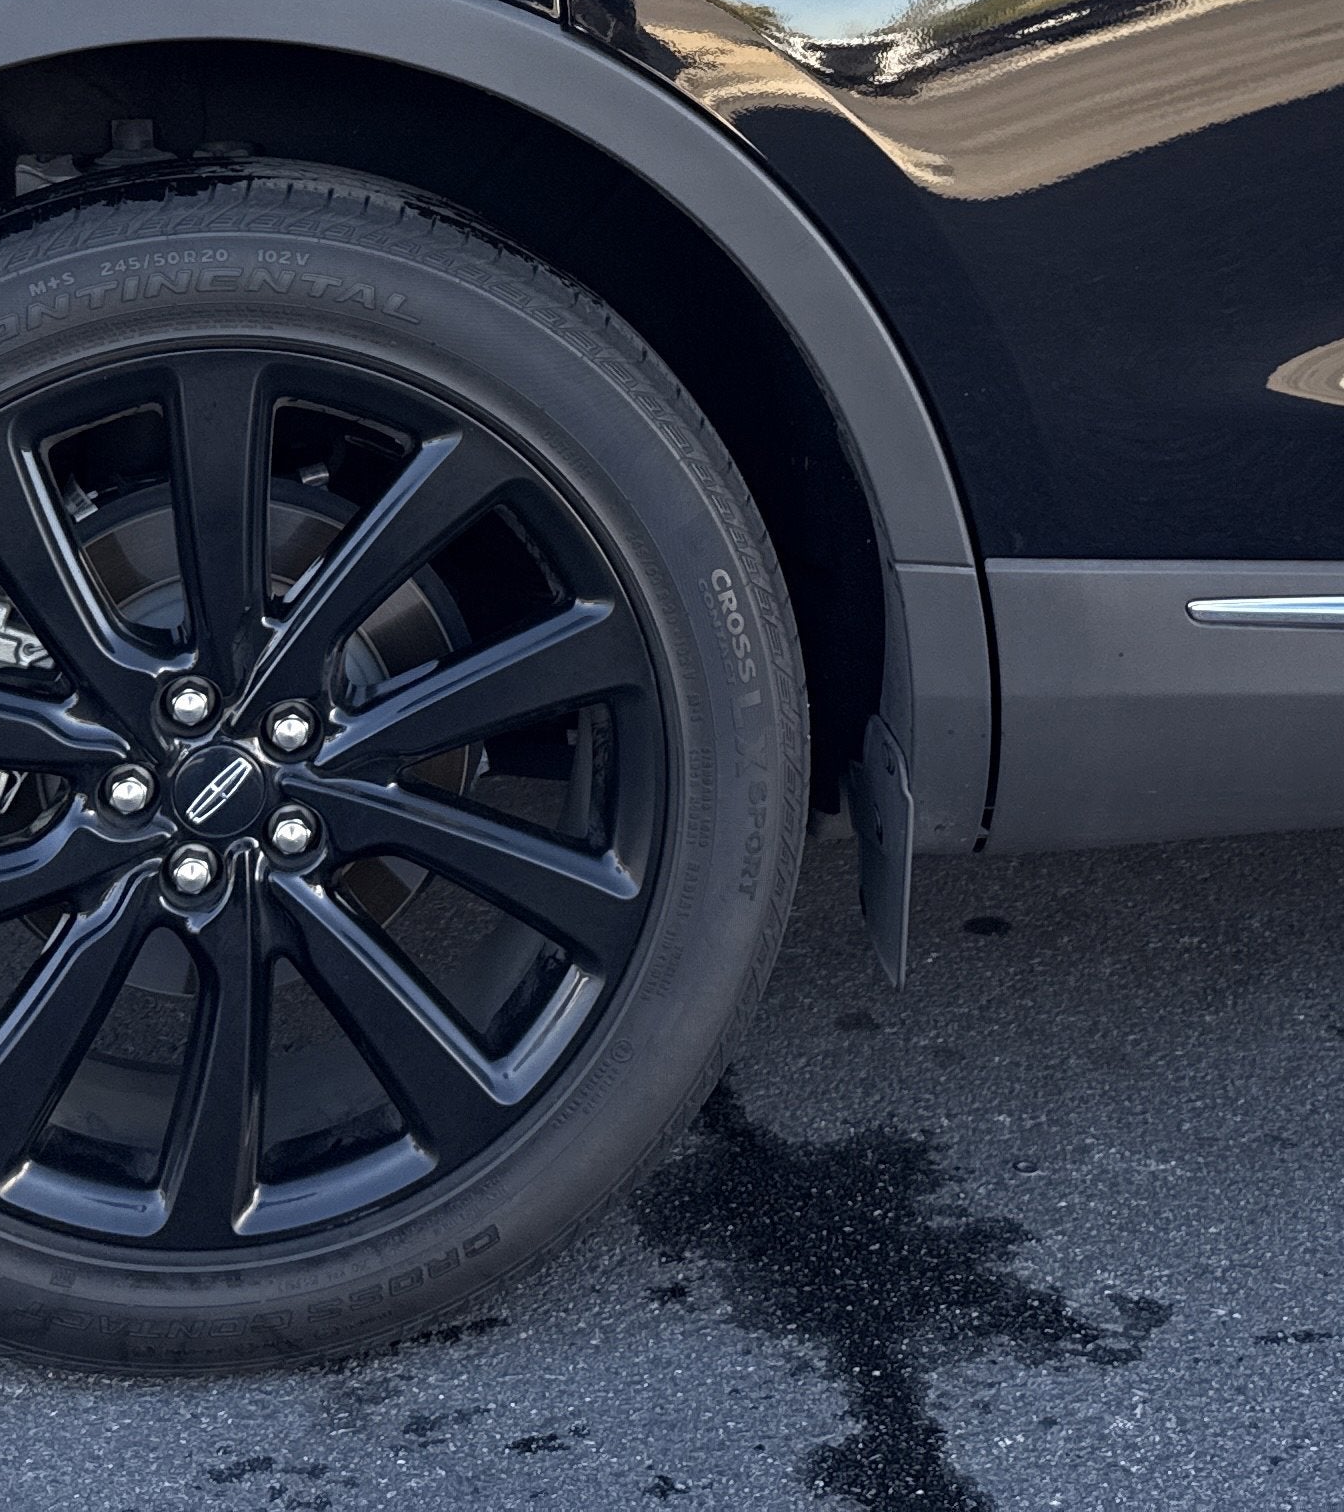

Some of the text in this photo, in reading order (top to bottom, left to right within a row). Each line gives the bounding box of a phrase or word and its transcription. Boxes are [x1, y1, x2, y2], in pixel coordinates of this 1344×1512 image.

[28, 271, 76, 298] M+S
[711, 568, 756, 684] CROSS
[739, 780, 768, 902] SPORT
[308, 1224, 500, 1323] CROSS
